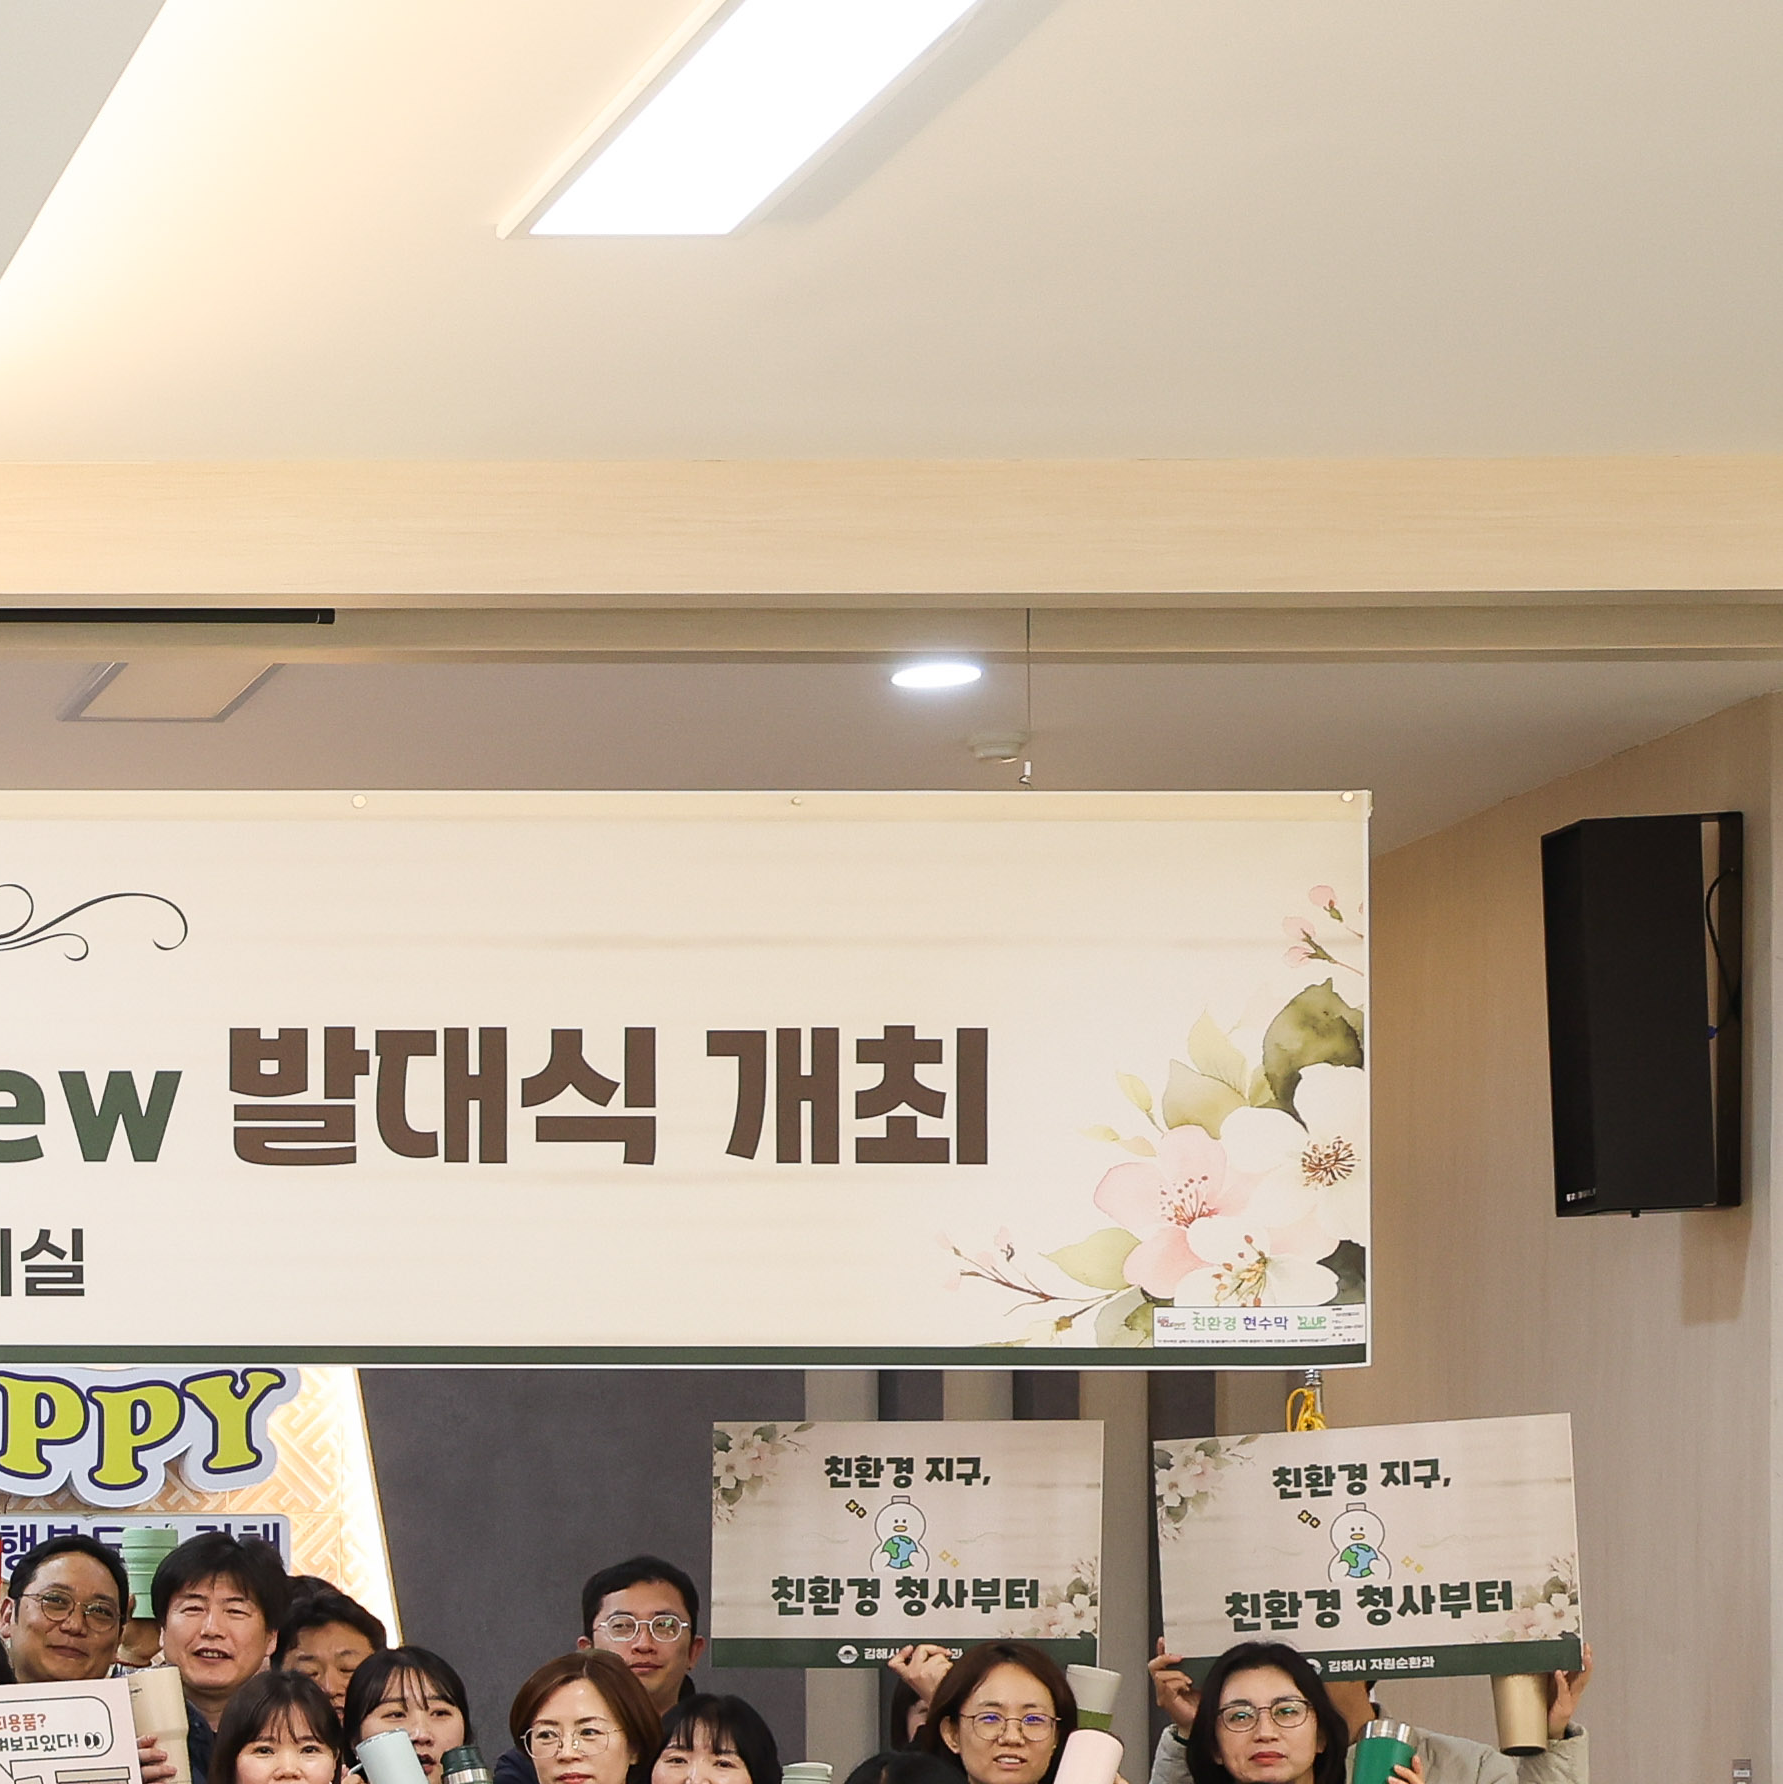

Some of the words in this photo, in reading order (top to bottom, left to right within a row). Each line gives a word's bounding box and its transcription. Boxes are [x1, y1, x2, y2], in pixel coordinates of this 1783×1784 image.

[229, 1024, 660, 1168] 발대식
[705, 1024, 990, 1167] 개최
[1192, 1315, 1237, 1331] 친환경
[1242, 1315, 1289, 1331] 현수막
[824, 1455, 915, 1489] 친환경
[925, 1456, 991, 1487] 지구,
[1271, 1463, 1369, 1500] 친환경
[1380, 1458, 1451, 1488] 지구,
[771, 1575, 881, 1617] 친환경
[894, 1575, 1040, 1618] 청사부터
[1224, 1588, 1342, 1632] 친환경
[1356, 1580, 1514, 1627] 청사부터
[1327, 1658, 1367, 1673] 김해시
[1369, 1656, 1436, 1672] 자원순환과
